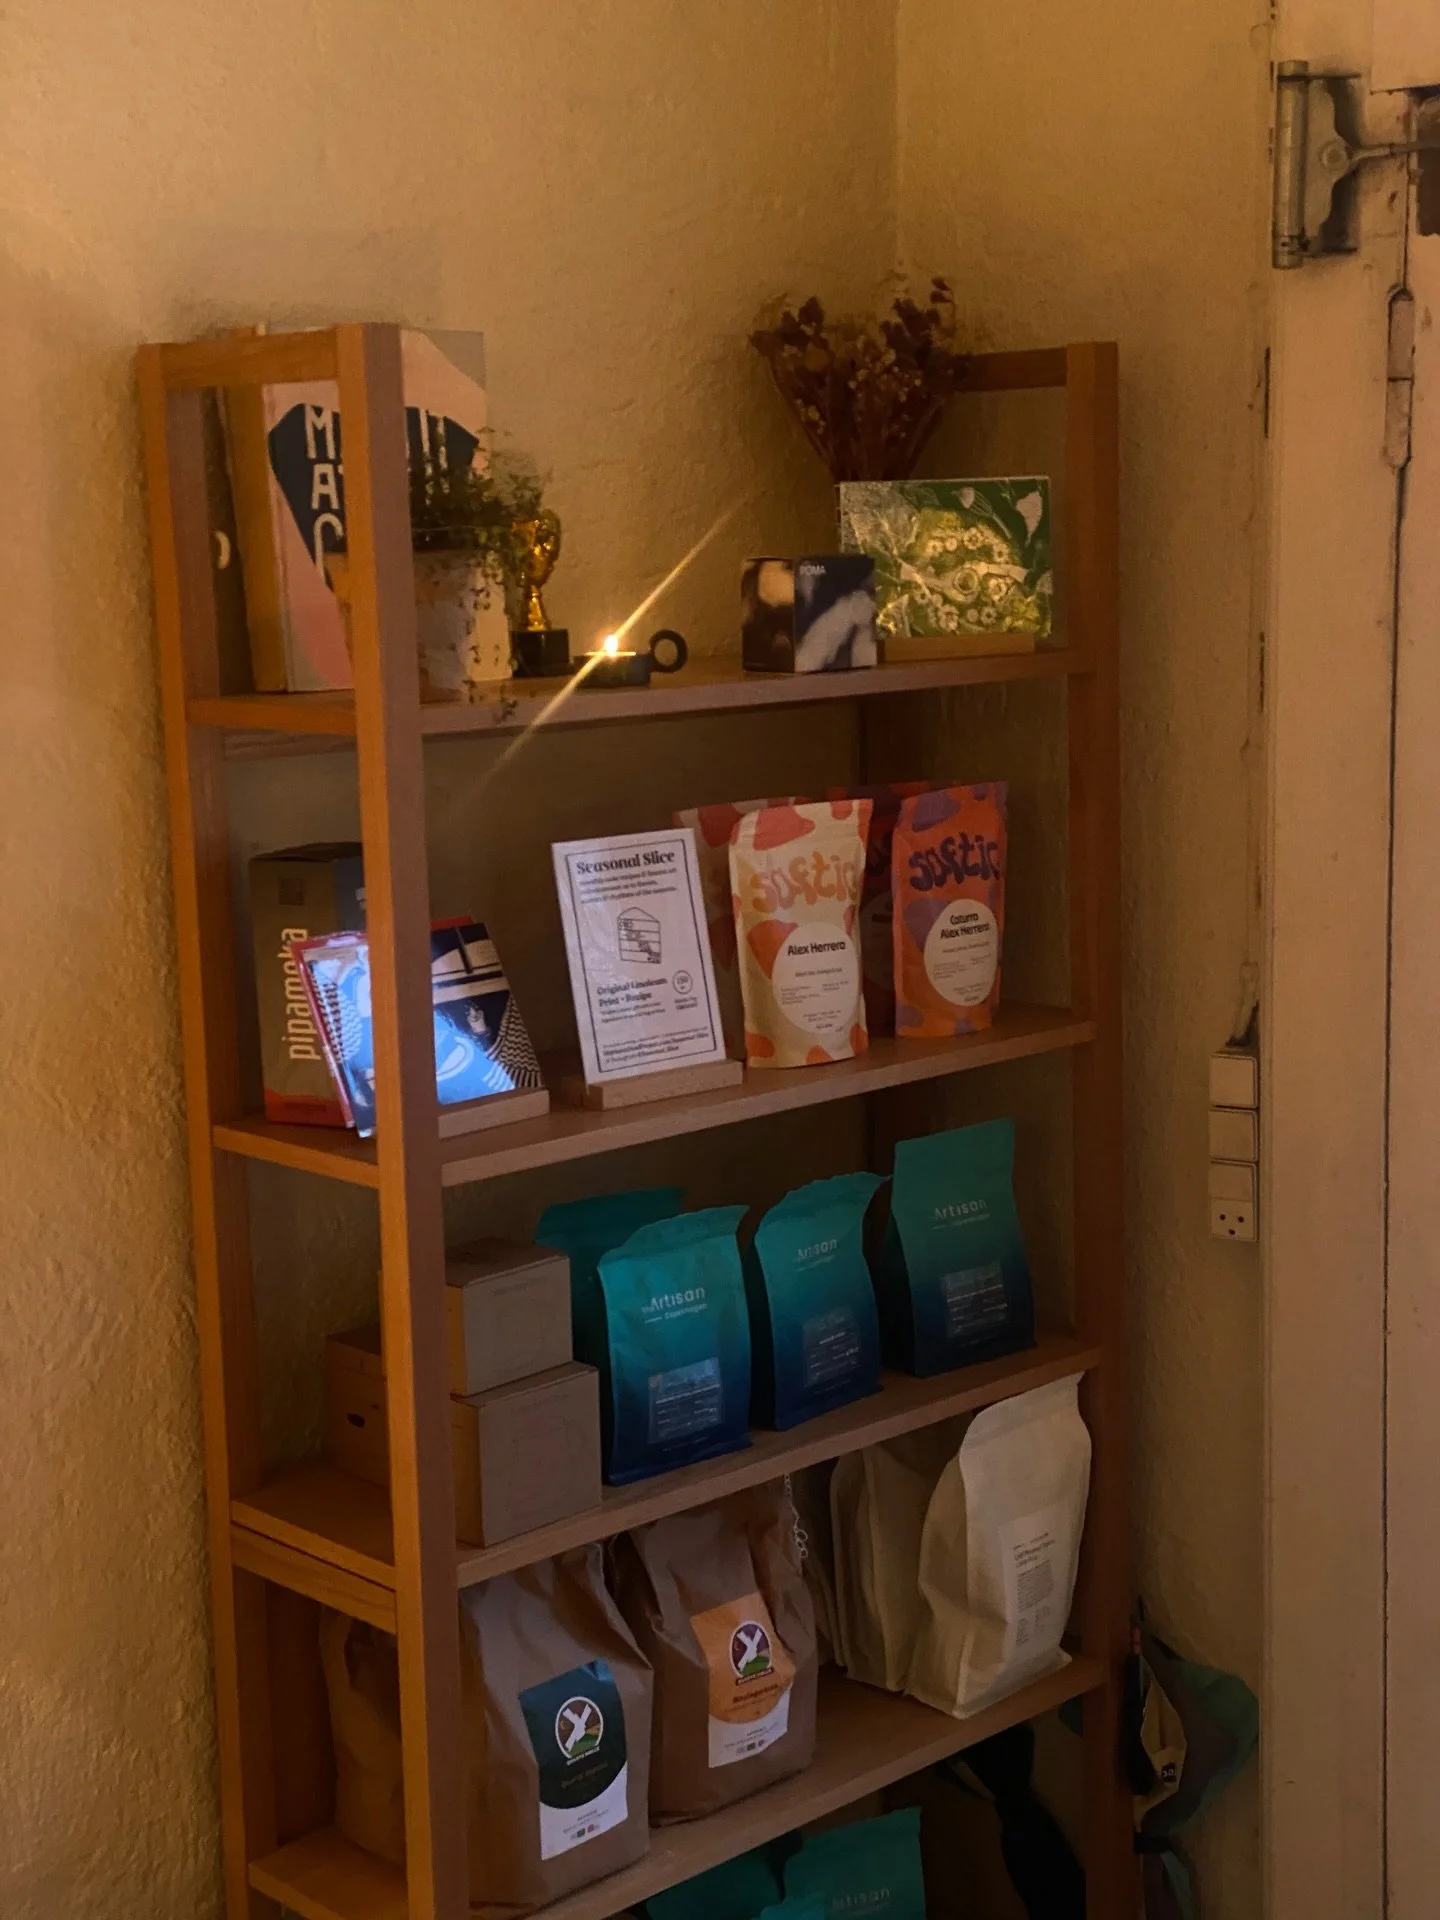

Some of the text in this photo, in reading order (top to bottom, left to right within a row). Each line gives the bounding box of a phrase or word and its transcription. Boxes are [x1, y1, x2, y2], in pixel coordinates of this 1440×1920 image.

[576, 850, 675, 874] Seasonal Slice
[940, 926, 960, 939] Alex
[787, 941, 846, 956] Alex Herrera
[597, 982, 630, 995] Original
[934, 1199, 988, 1219] Artisan
[651, 1287, 706, 1311] Artisan
